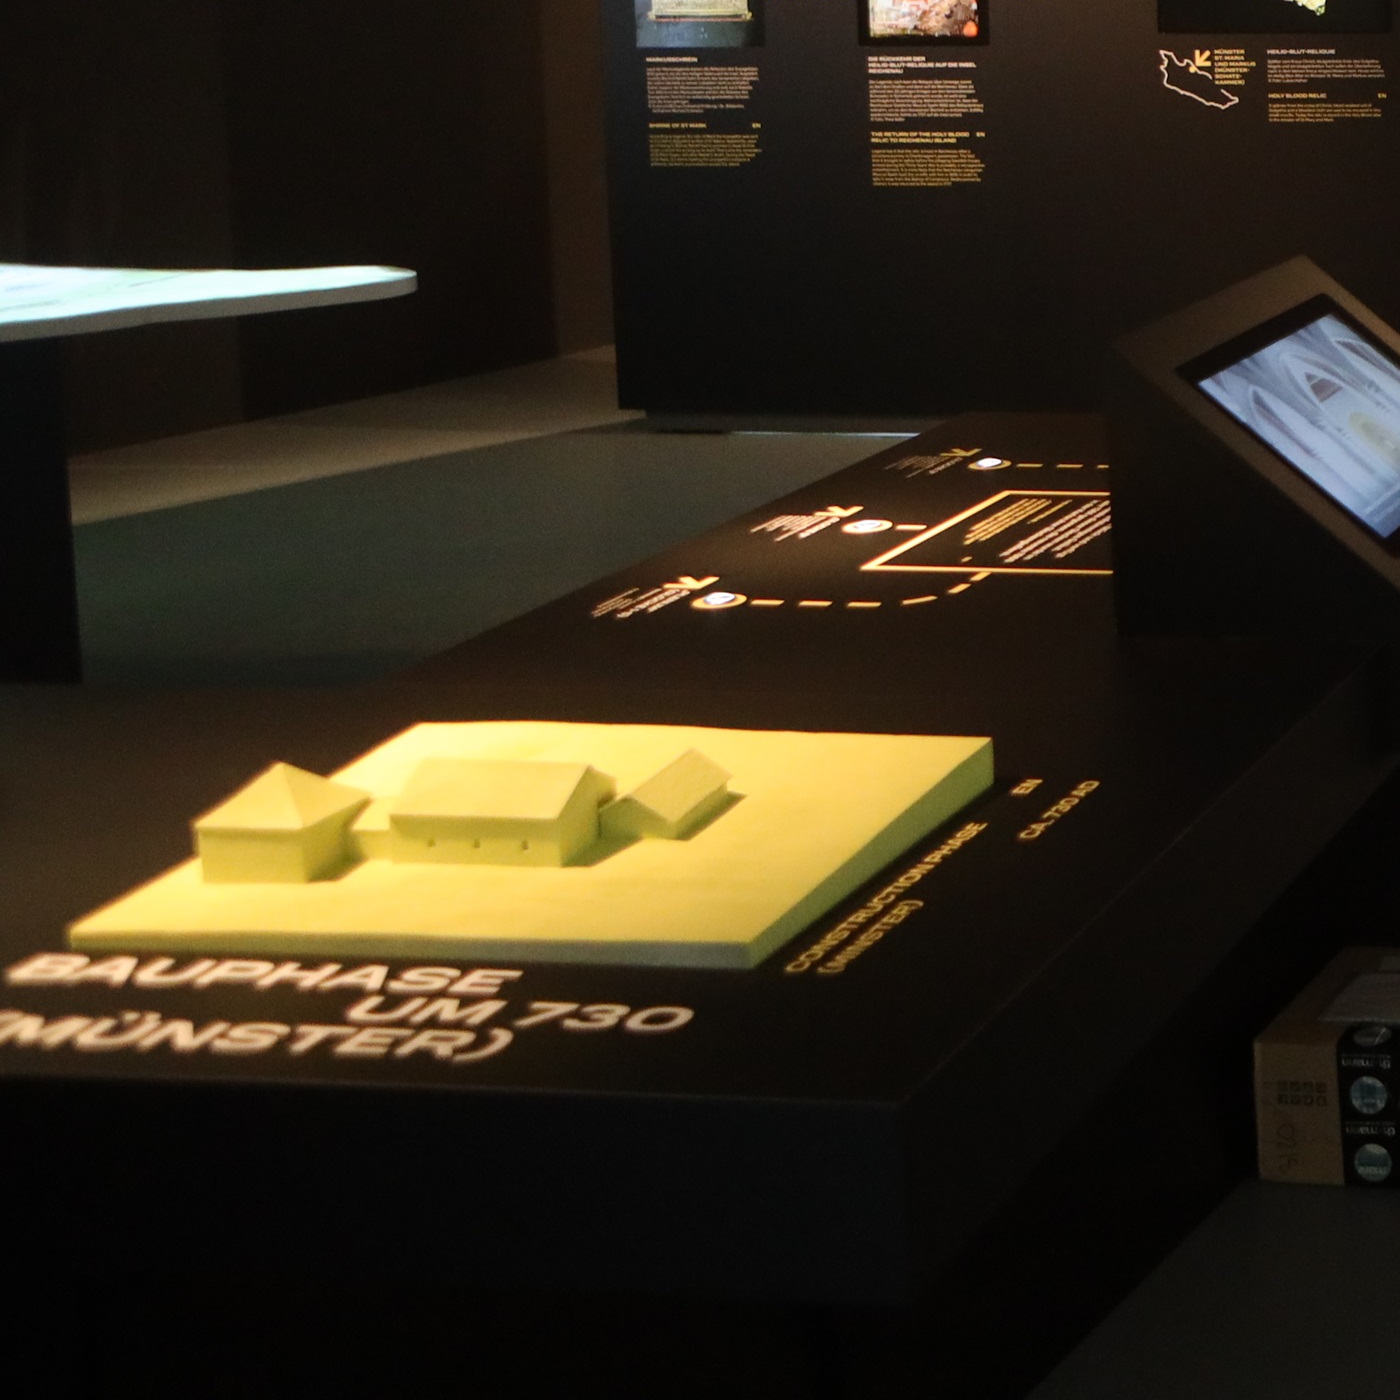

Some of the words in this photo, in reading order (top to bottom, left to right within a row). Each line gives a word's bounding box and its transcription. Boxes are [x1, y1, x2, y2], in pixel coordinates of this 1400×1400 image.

[1009, 777, 1044, 797] EN
[783, 858, 936, 975] CONSTRUCTION
[926, 821, 989, 870] PHASE
[7, 953, 523, 994] BAUPHASE
[346, 995, 507, 1025] UM
[512, 1001, 695, 1033] 730
